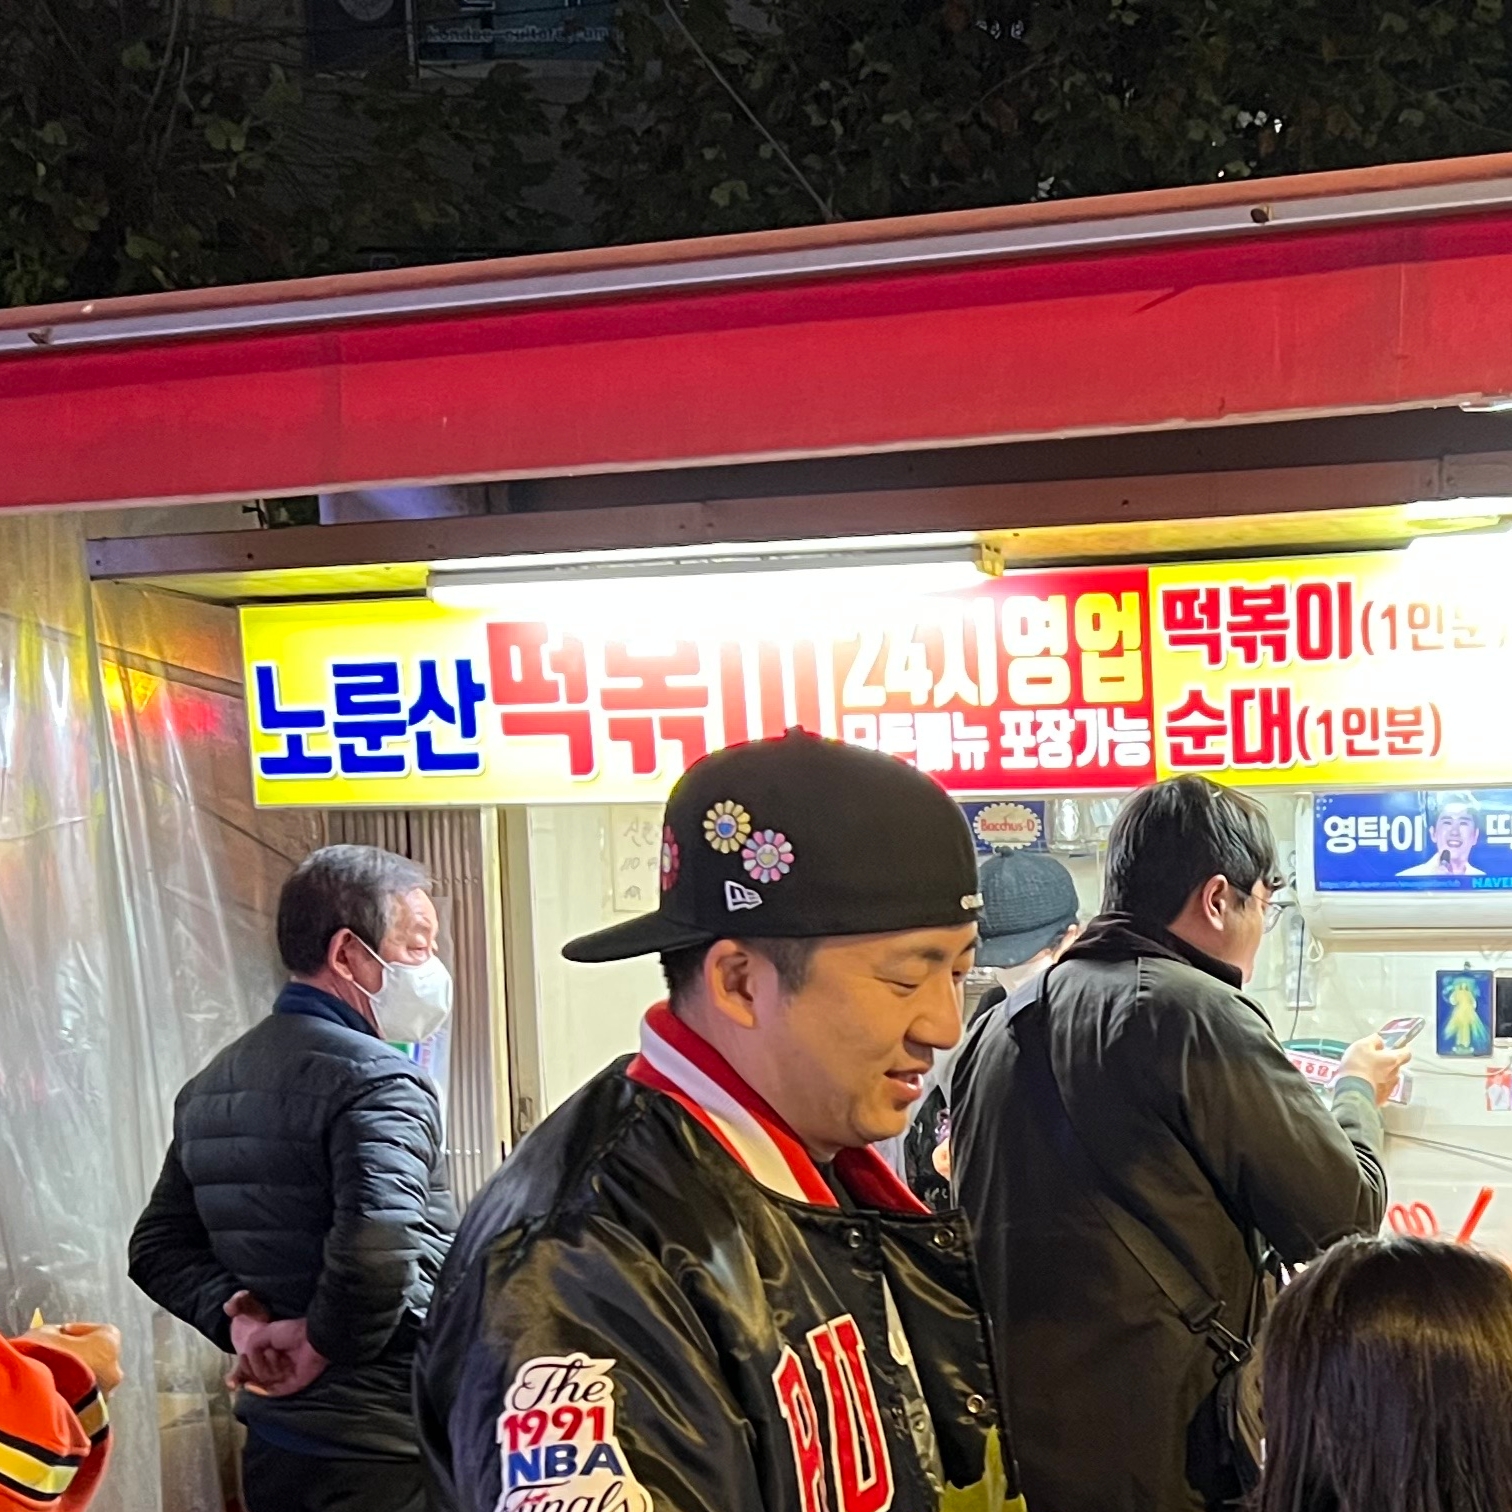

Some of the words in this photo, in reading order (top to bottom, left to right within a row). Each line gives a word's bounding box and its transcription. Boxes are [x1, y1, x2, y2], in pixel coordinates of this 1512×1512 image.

[842, 592, 1144, 708] 24시영업
[256, 658, 486, 776] 노룬산
[1000, 706, 1152, 770] 포장가능
[1322, 814, 1423, 853] 영탁이
[512, 1359, 608, 1411] The
[504, 1405, 606, 1453] 1991
[507, 1442, 625, 1489] NBA
